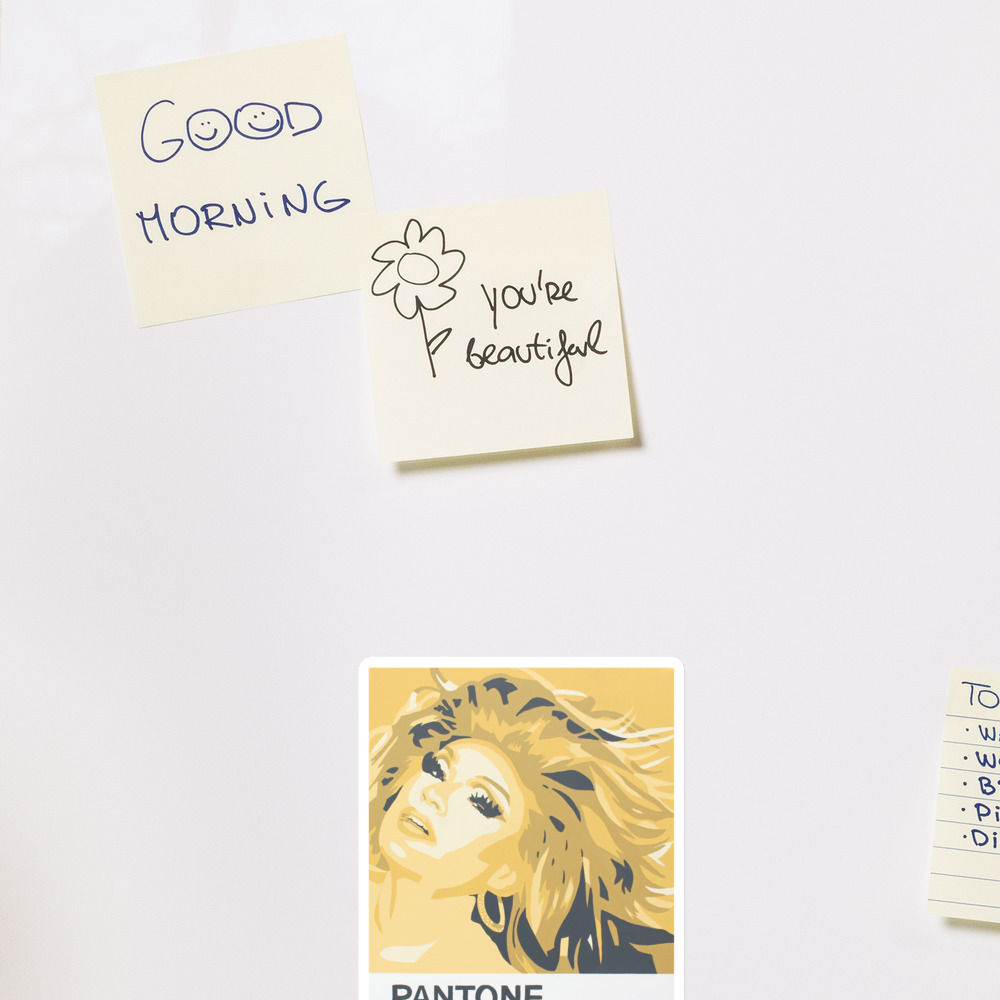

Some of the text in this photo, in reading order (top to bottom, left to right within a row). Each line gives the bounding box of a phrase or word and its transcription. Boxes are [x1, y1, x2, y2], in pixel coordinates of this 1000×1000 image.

[140, 99, 323, 164] GOOD
[465, 319, 608, 387] beautiful
[961, 681, 1000, 709] TO
